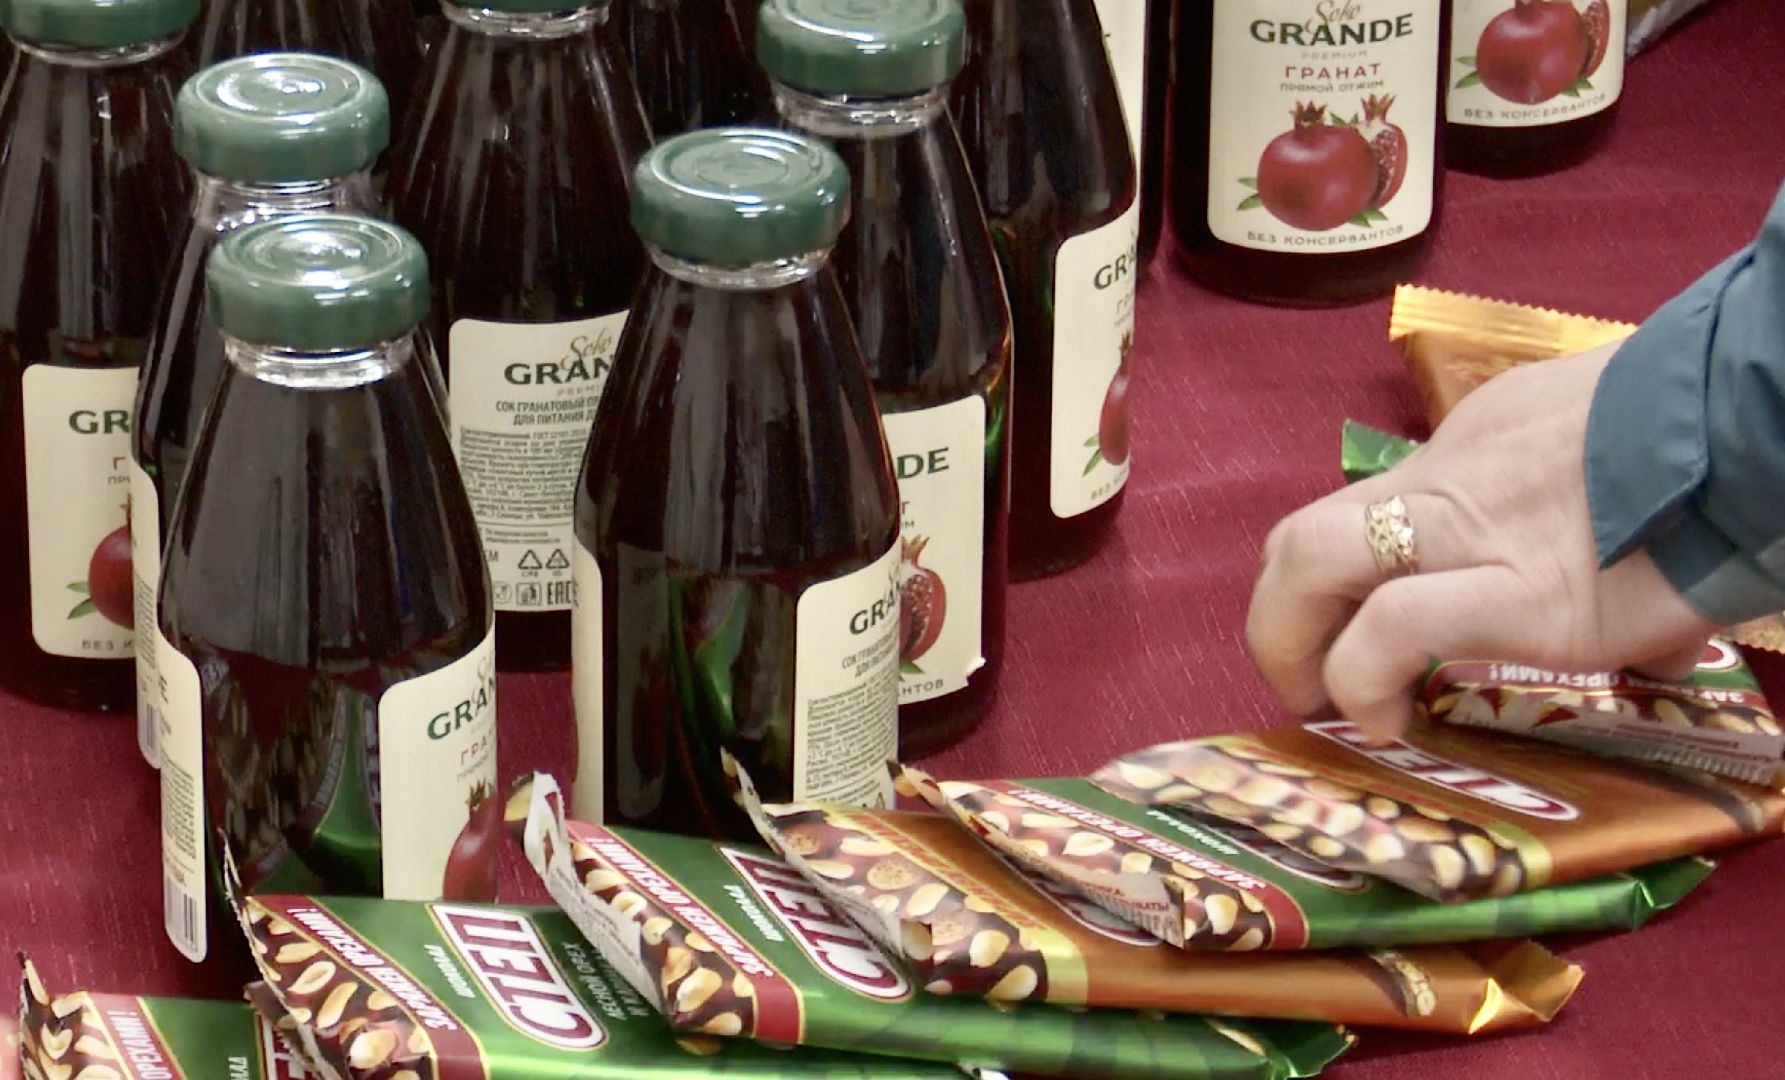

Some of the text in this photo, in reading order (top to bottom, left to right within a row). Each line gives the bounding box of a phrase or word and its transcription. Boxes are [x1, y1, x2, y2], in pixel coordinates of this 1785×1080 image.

[1250, 13, 1413, 46] GRANDE
[1301, 51, 1368, 60] PREMIUM
[1285, 63, 1381, 80] ГРАНАТ
[1280, 80, 1384, 92] ПРЯМОЙ ОТЖИМ
[1464, 108, 1494, 119] БЕЗ
[1247, 225, 1404, 246] БЕЗ КОНСЕРВАНТОВ
[496, 400, 516, 412] СОК
[517, 398, 584, 413] ГРАНАТОВЫЙ
[513, 415, 535, 426] ДЛЯ
[537, 412, 583, 425] ПИТАНИЯ
[82, 639, 114, 651] БЕЗ
[1137, 839, 1266, 890] ЗАРЯЖЕН
[586, 837, 774, 977] ЗАРЯЖЕН ОРЕХАМИ!
[561, 942, 596, 973] ОРЕХ
[287, 908, 458, 1031] ЗАРЯЖЕН ОРЕХАМИ!
[444, 911, 595, 1041] СТЕП
[106, 1010, 173, 1080] ОРЕХАМИ!
